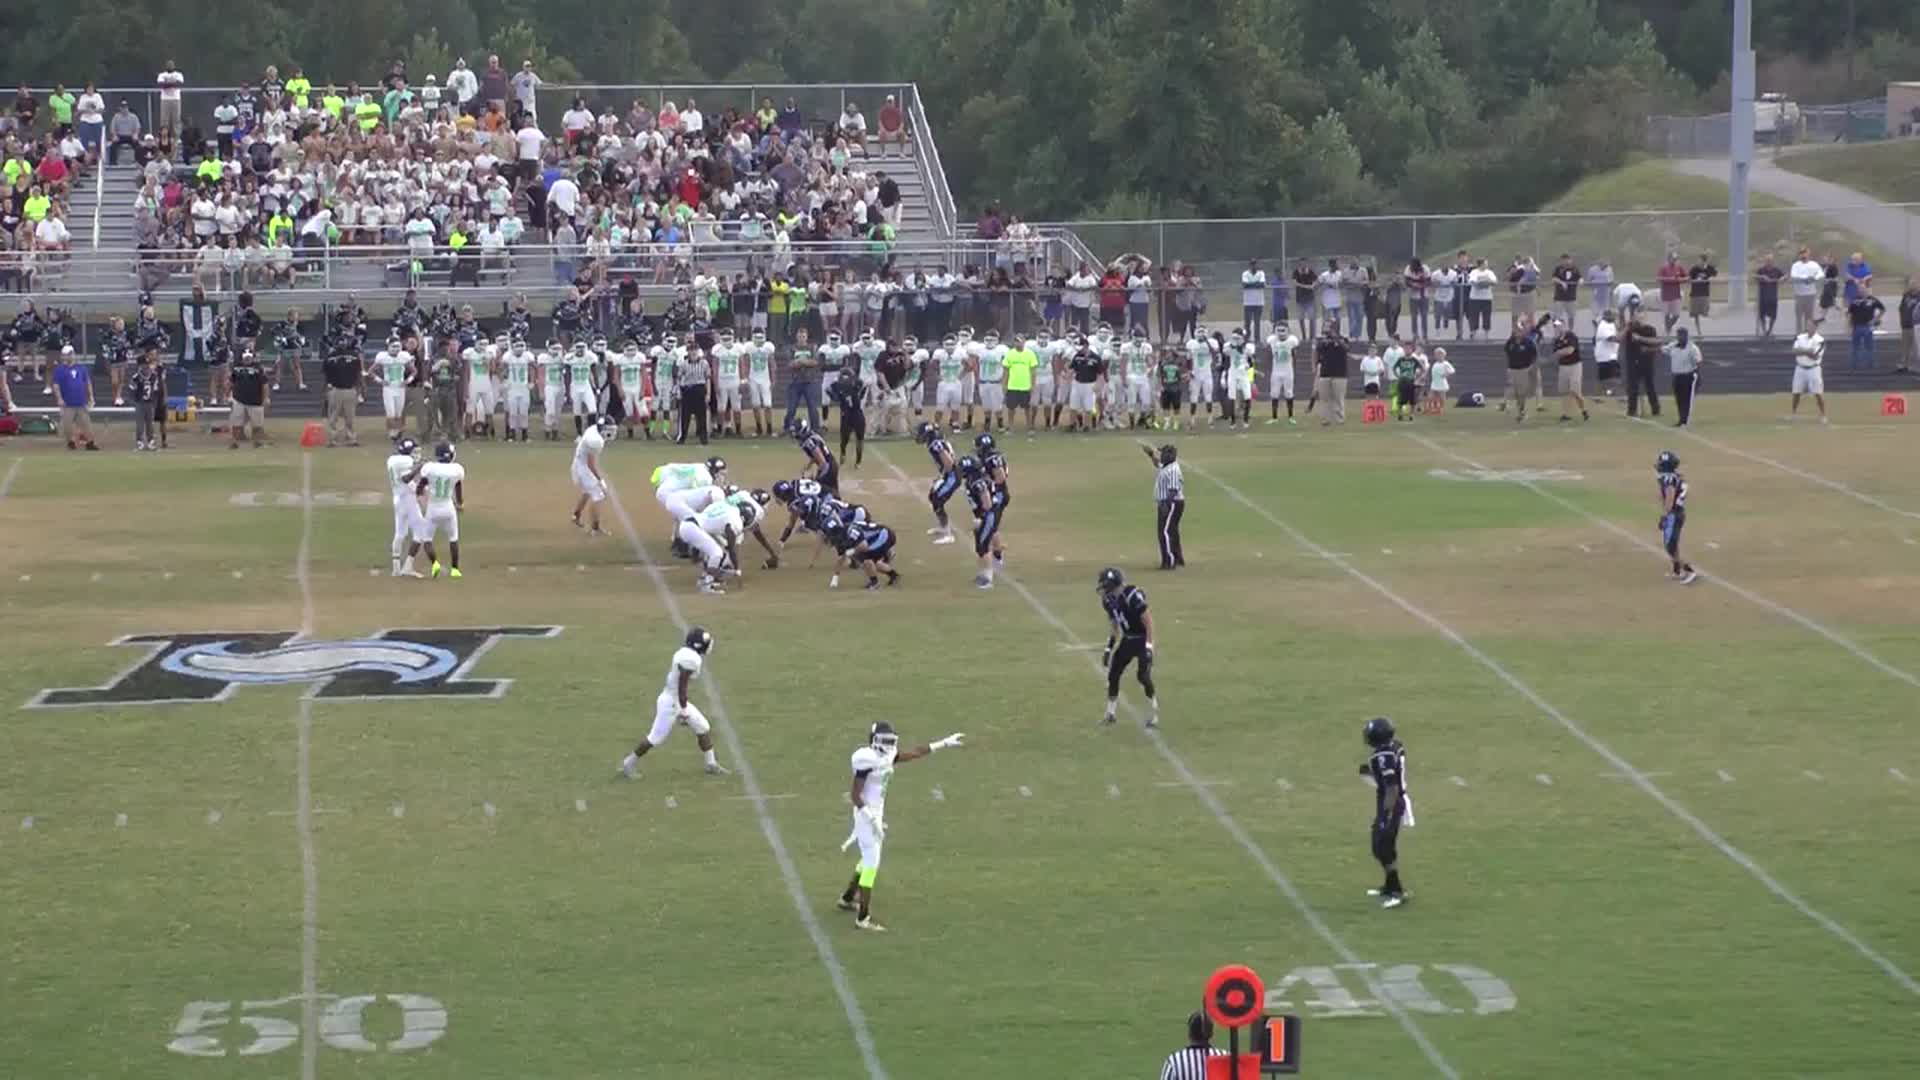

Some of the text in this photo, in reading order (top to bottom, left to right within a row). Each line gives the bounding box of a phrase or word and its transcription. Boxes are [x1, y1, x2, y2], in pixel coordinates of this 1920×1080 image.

[182, 305, 214, 361] H
[1366, 404, 1386, 422] 30
[1887, 397, 1905, 415] 20
[167, 992, 450, 1057] 50
[1265, 1017, 1285, 1063] 1
